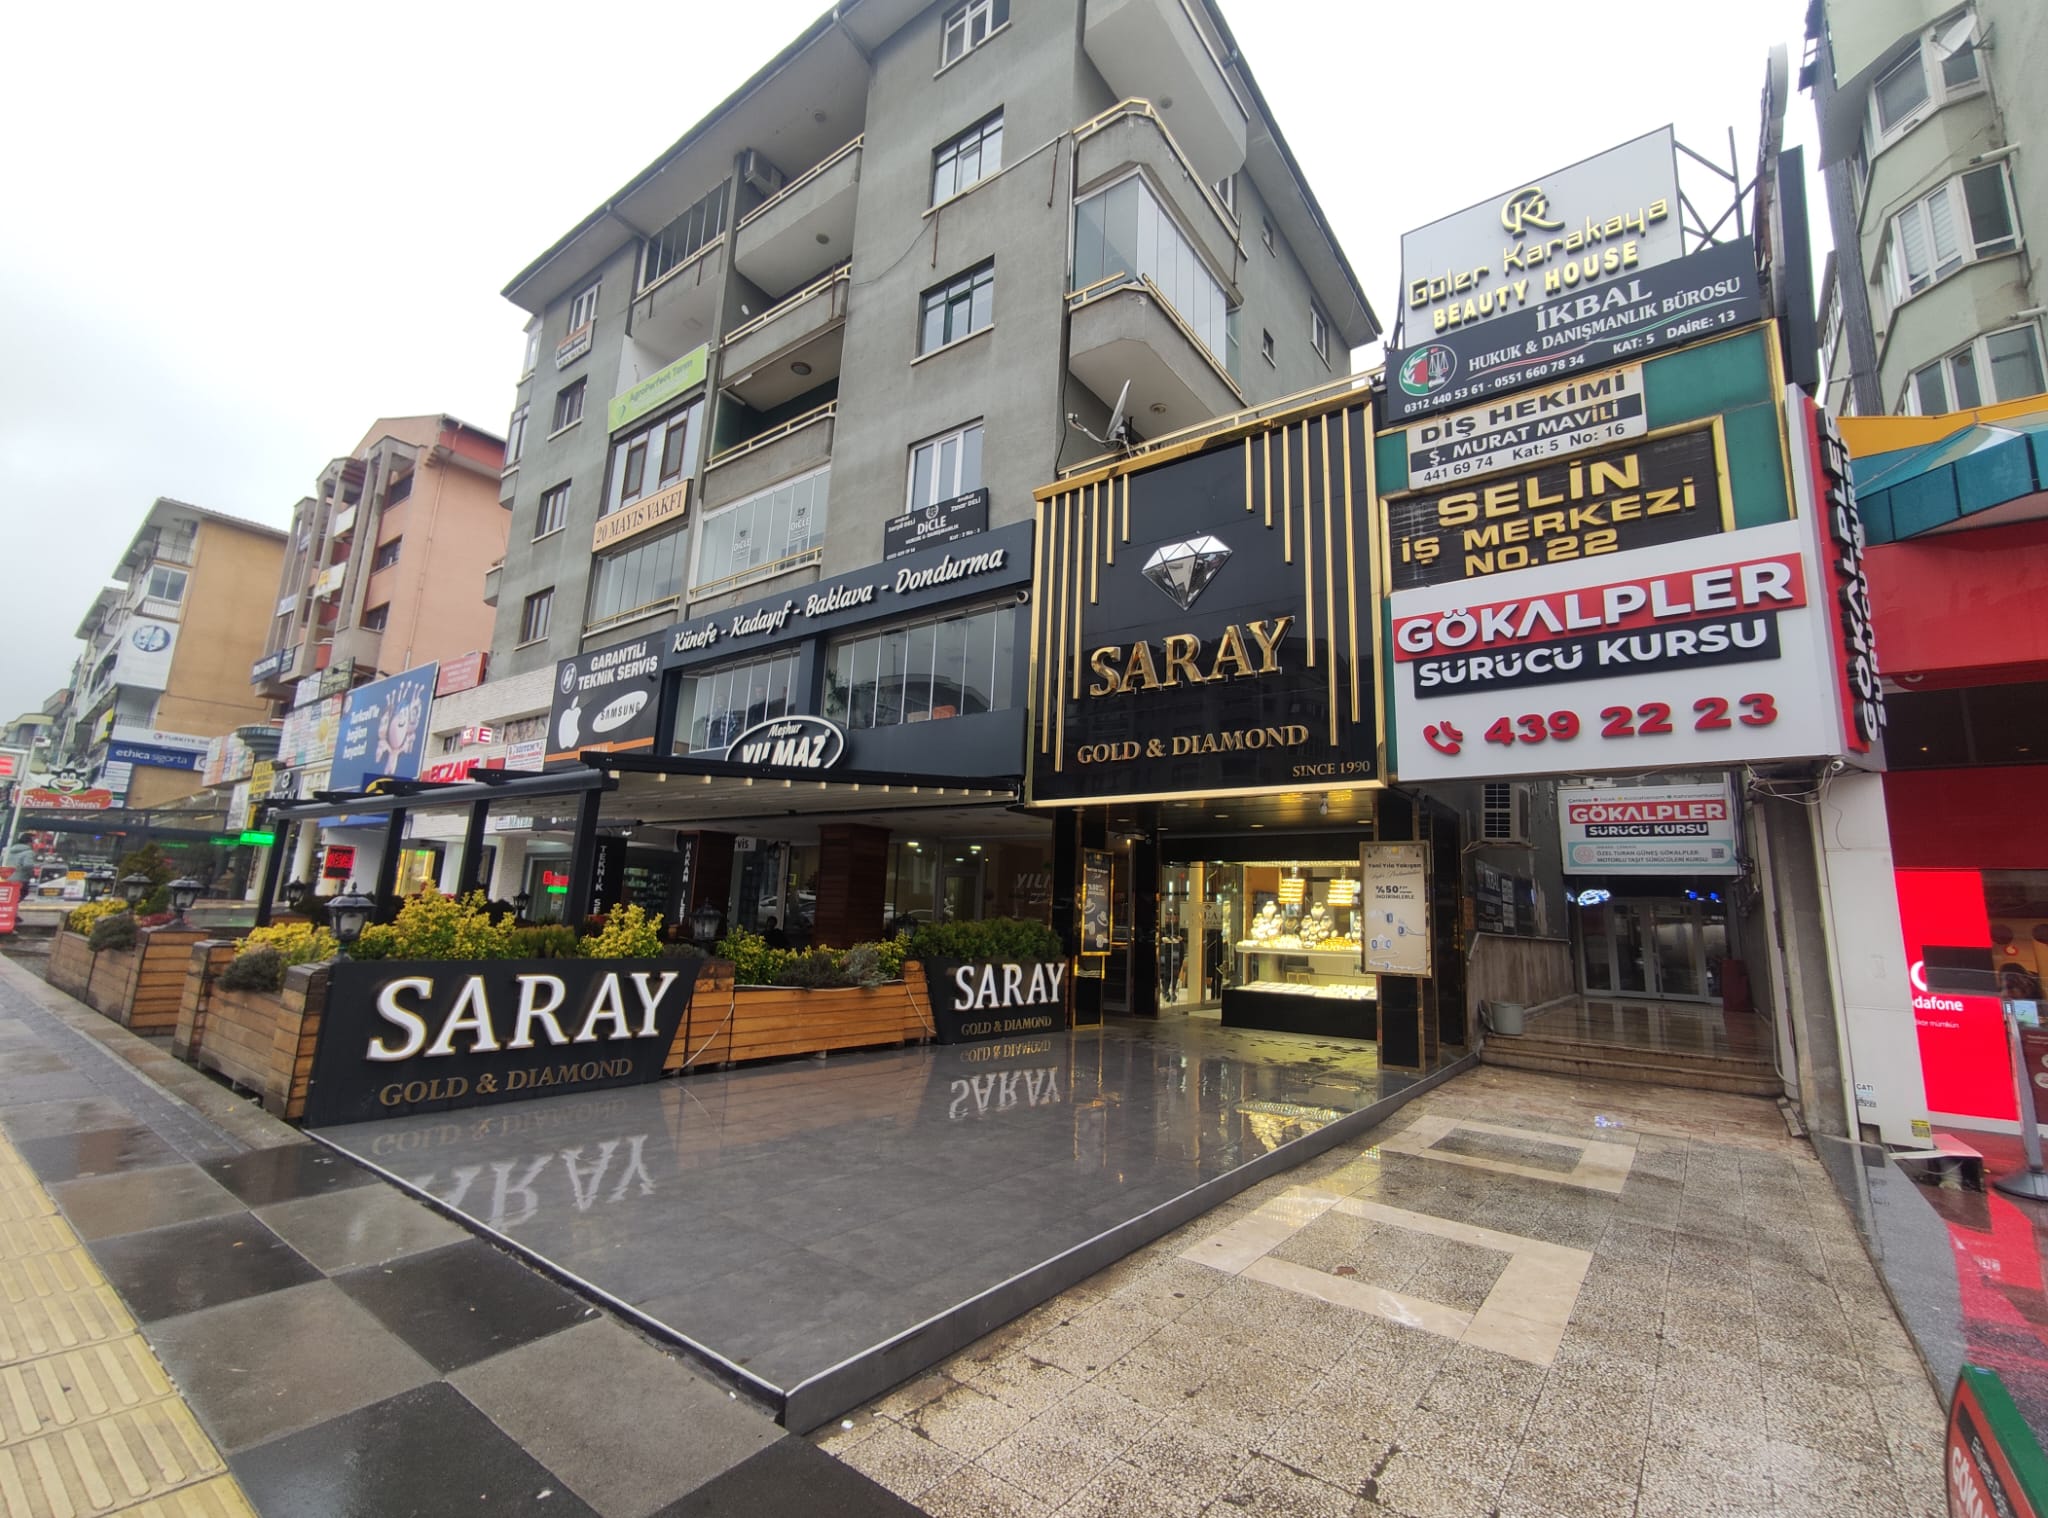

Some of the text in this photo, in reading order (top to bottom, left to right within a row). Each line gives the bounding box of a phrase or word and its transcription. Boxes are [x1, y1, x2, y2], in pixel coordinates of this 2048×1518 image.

[1503, 198, 1668, 275] Karakaya
[1433, 240, 1638, 331] BEAUTY HOUSE
[1536, 280, 1653, 332] İKBAL
[1469, 277, 1741, 371] HUKUK & DANIŞMANLIK BÜROSU
[1404, 400, 1430, 414] 0312
[1432, 394, 1451, 406] 440
[1454, 388, 1468, 400] 53
[1471, 384, 1484, 395] 61
[1494, 372, 1522, 387] 0551
[1525, 365, 1548, 379] 660
[1551, 359, 1566, 372] 78
[1569, 354, 1585, 368] 34
[1613, 338, 1642, 354] KAT:
[1646, 333, 1655, 345] 5
[1666, 318, 1713, 339] DAİRE:
[1718, 310, 1736, 325] 13
[1421, 370, 1625, 445] DİŞ HEKİMİ
[1453, 428, 1529, 458] MURAT
[1537, 400, 1618, 436] MAVİLİ
[1424, 423, 1625, 482] 441 69 74 Kat: 5 No: 16
[609, 508, 645, 538] MAYIS
[647, 489, 683, 521] VAKFI
[1438, 454, 1641, 527] SELİN
[1402, 477, 1696, 565] İŞ MERKEZİ
[672, 622, 717, 653] Künefe
[730, 600, 793, 638] Kadayıf
[806, 582, 873, 617] Baklava
[895, 549, 1004, 594] Dondurma
[1397, 561, 1794, 653] GÖKALPLER
[578, 656, 658, 691] TEKNİK SERVİS
[591, 641, 647, 672] GARANTİLİ
[1090, 615, 1295, 697] SARAY
[1418, 618, 1768, 687] SÜRÜCÜ KURSU
[601, 702, 641, 721] SAMSUNG
[1484, 692, 1778, 745] 439 22 23
[115, 749, 150, 760] ethica
[1077, 725, 1309, 764] GOLD & DIAMOND
[1292, 760, 1370, 777] SINCE 1990
[1572, 803, 1724, 821] GÖKALPLER
[1589, 824, 1708, 836] SÜRÜCÜ KURSU
[1376, 885, 1398, 893] %50
[955, 963, 1066, 1011] SARAY
[366, 972, 679, 1061] SARAY
[961, 1015, 1052, 1036] GOLD & DIAMOND
[379, 1058, 633, 1107] GOLD & DIAMOND
